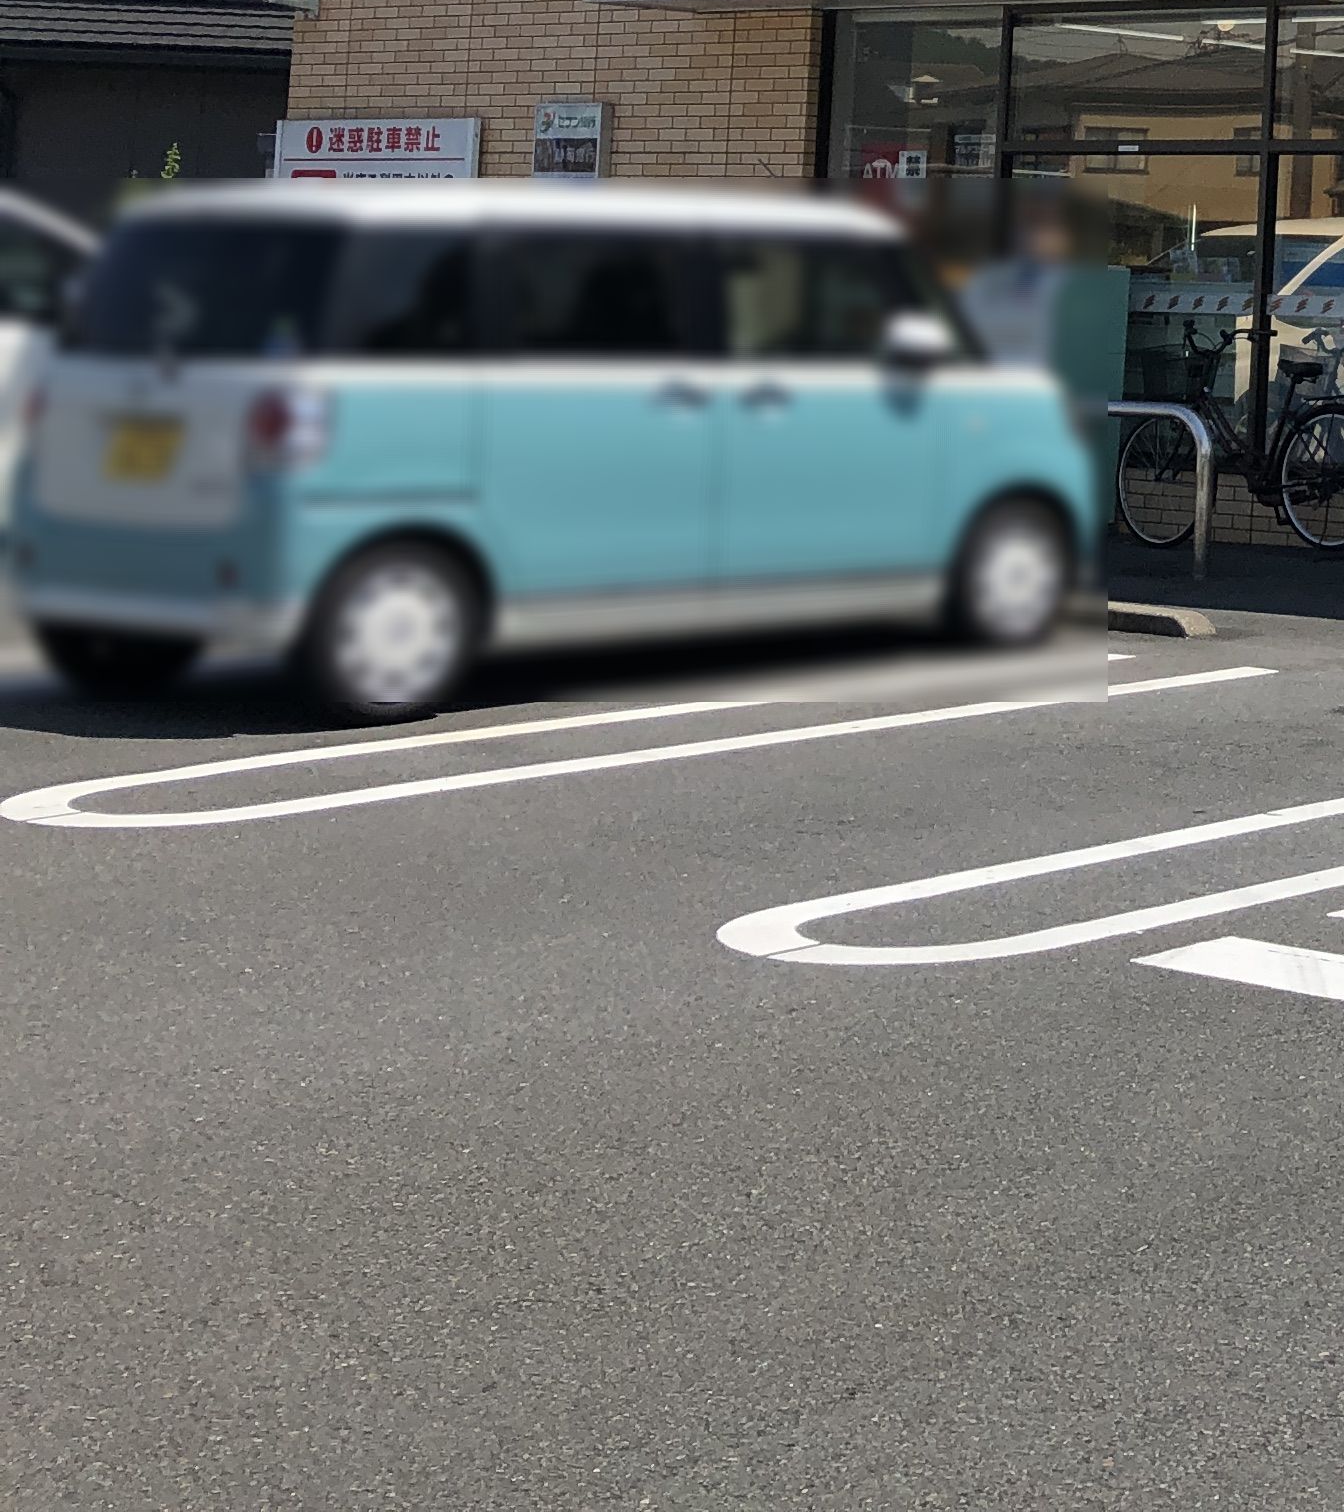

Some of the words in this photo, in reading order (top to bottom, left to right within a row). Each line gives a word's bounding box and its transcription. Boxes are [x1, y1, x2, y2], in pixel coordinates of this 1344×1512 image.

[327, 125, 441, 153] 迷惑駐車禁止
